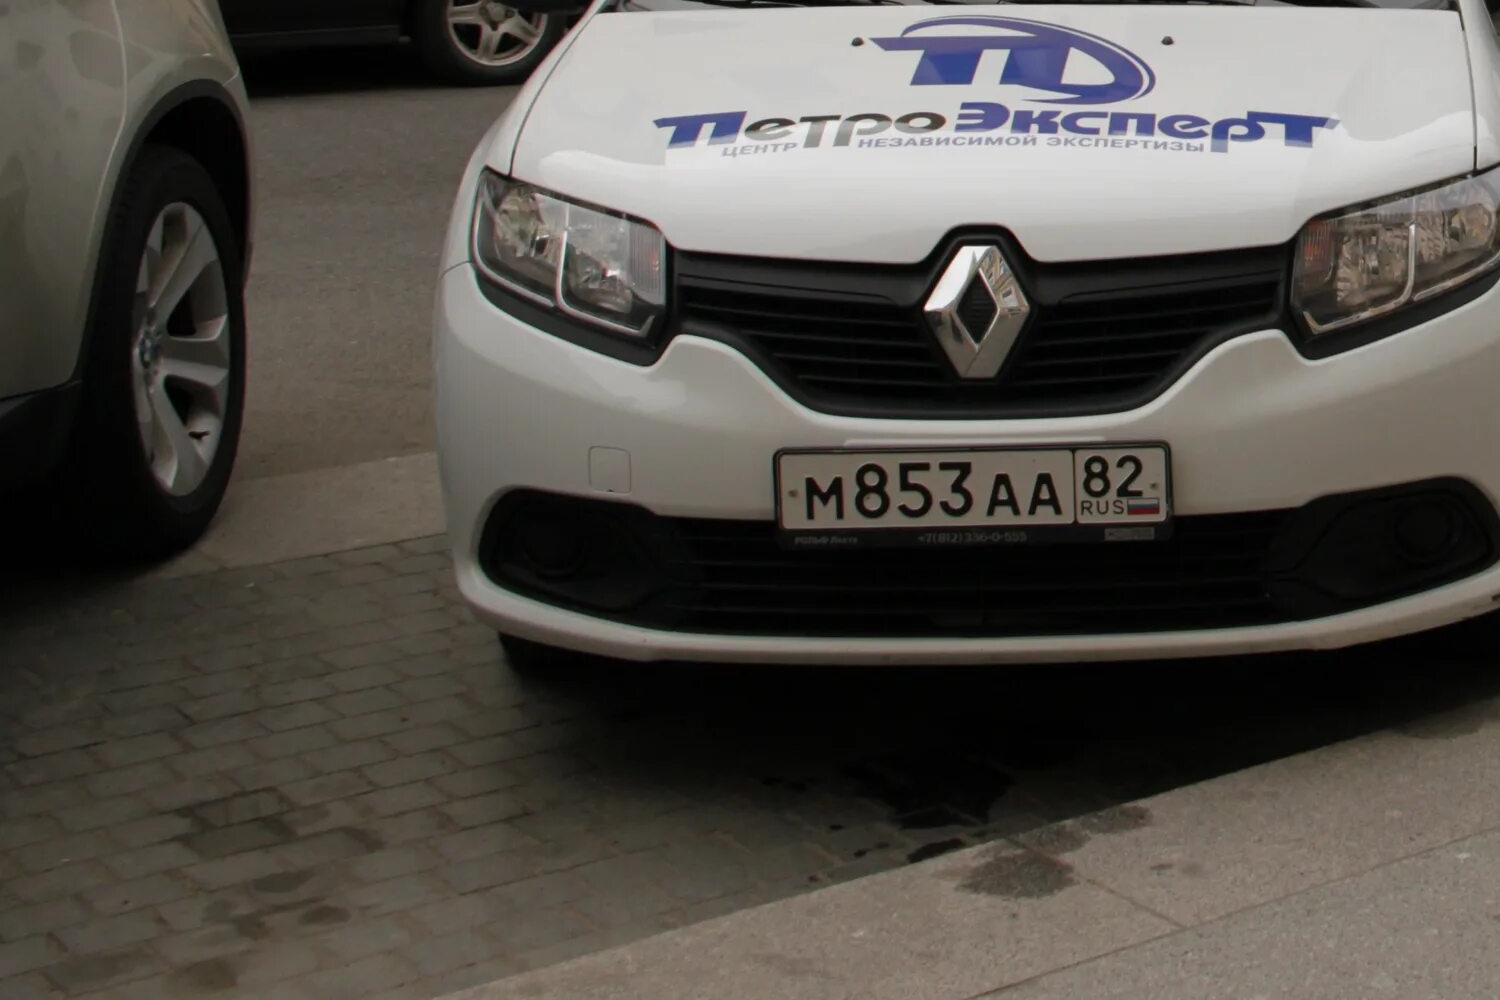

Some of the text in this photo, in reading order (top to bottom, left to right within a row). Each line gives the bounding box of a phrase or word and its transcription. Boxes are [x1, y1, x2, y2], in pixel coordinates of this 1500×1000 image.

[653, 101, 1341, 154] ПетроЭксперт
[721, 134, 1205, 158] ЦЕНТР НЕЗАВИСИМОЙ ЭКСПЕРТИЗЫ
[1083, 454, 1144, 498] 82
[1080, 498, 1125, 516] RUS
